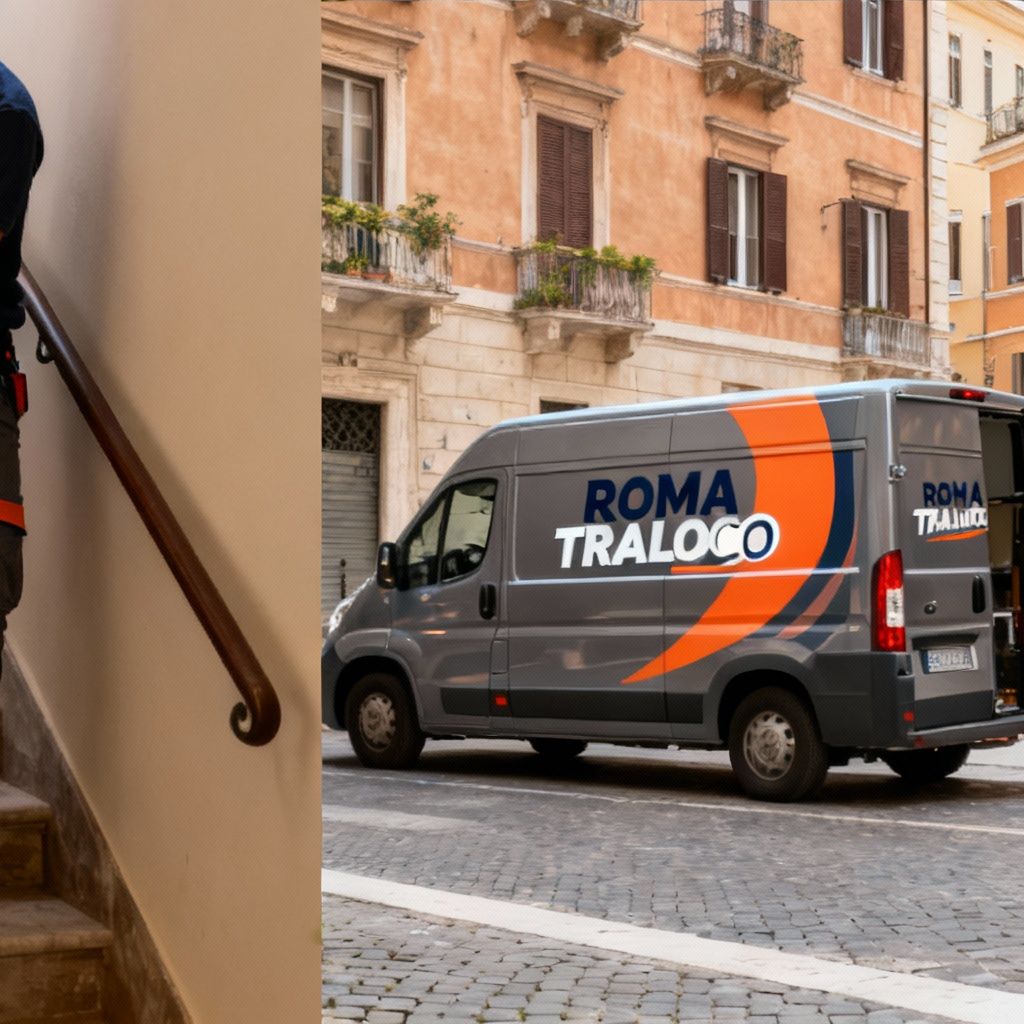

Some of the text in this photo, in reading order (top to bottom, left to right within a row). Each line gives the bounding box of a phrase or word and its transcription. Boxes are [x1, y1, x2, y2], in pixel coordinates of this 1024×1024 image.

[584, 470, 738, 524] ROMA
[923, 480, 983, 508] ROMA
[554, 512, 780, 568] TRALOCO
